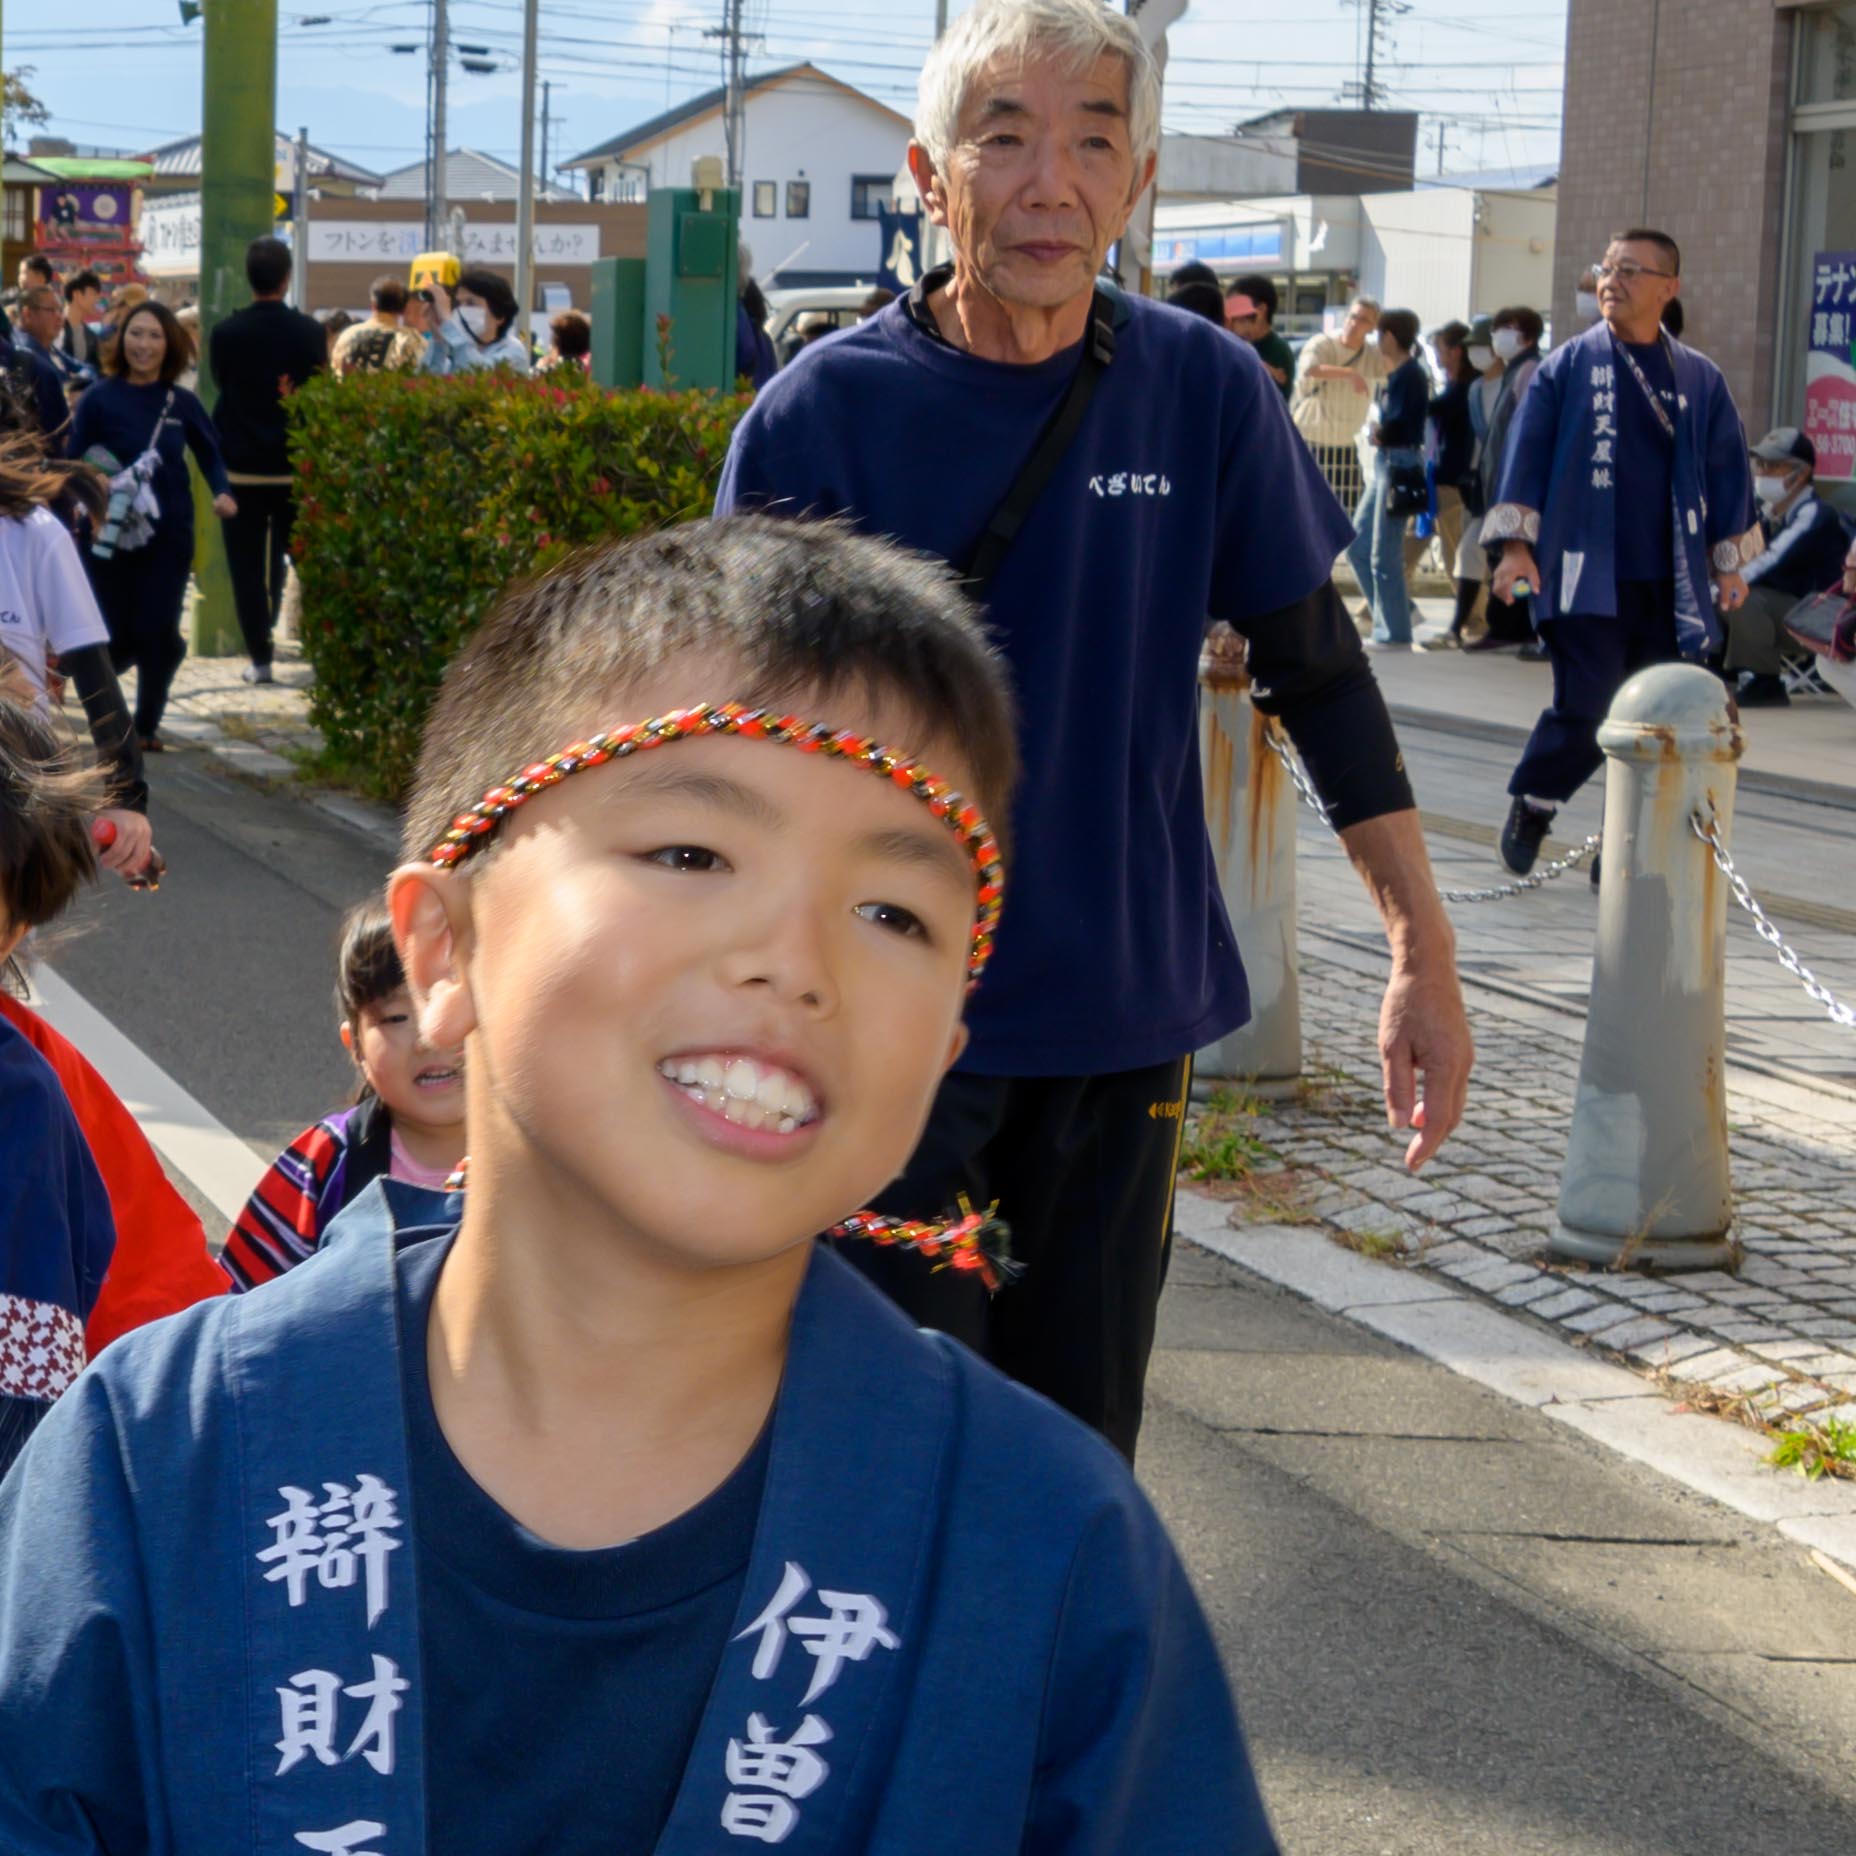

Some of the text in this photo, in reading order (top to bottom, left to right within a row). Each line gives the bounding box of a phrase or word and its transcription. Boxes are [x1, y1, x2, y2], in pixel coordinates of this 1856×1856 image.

[1088, 472, 1171, 498] べざいてん
